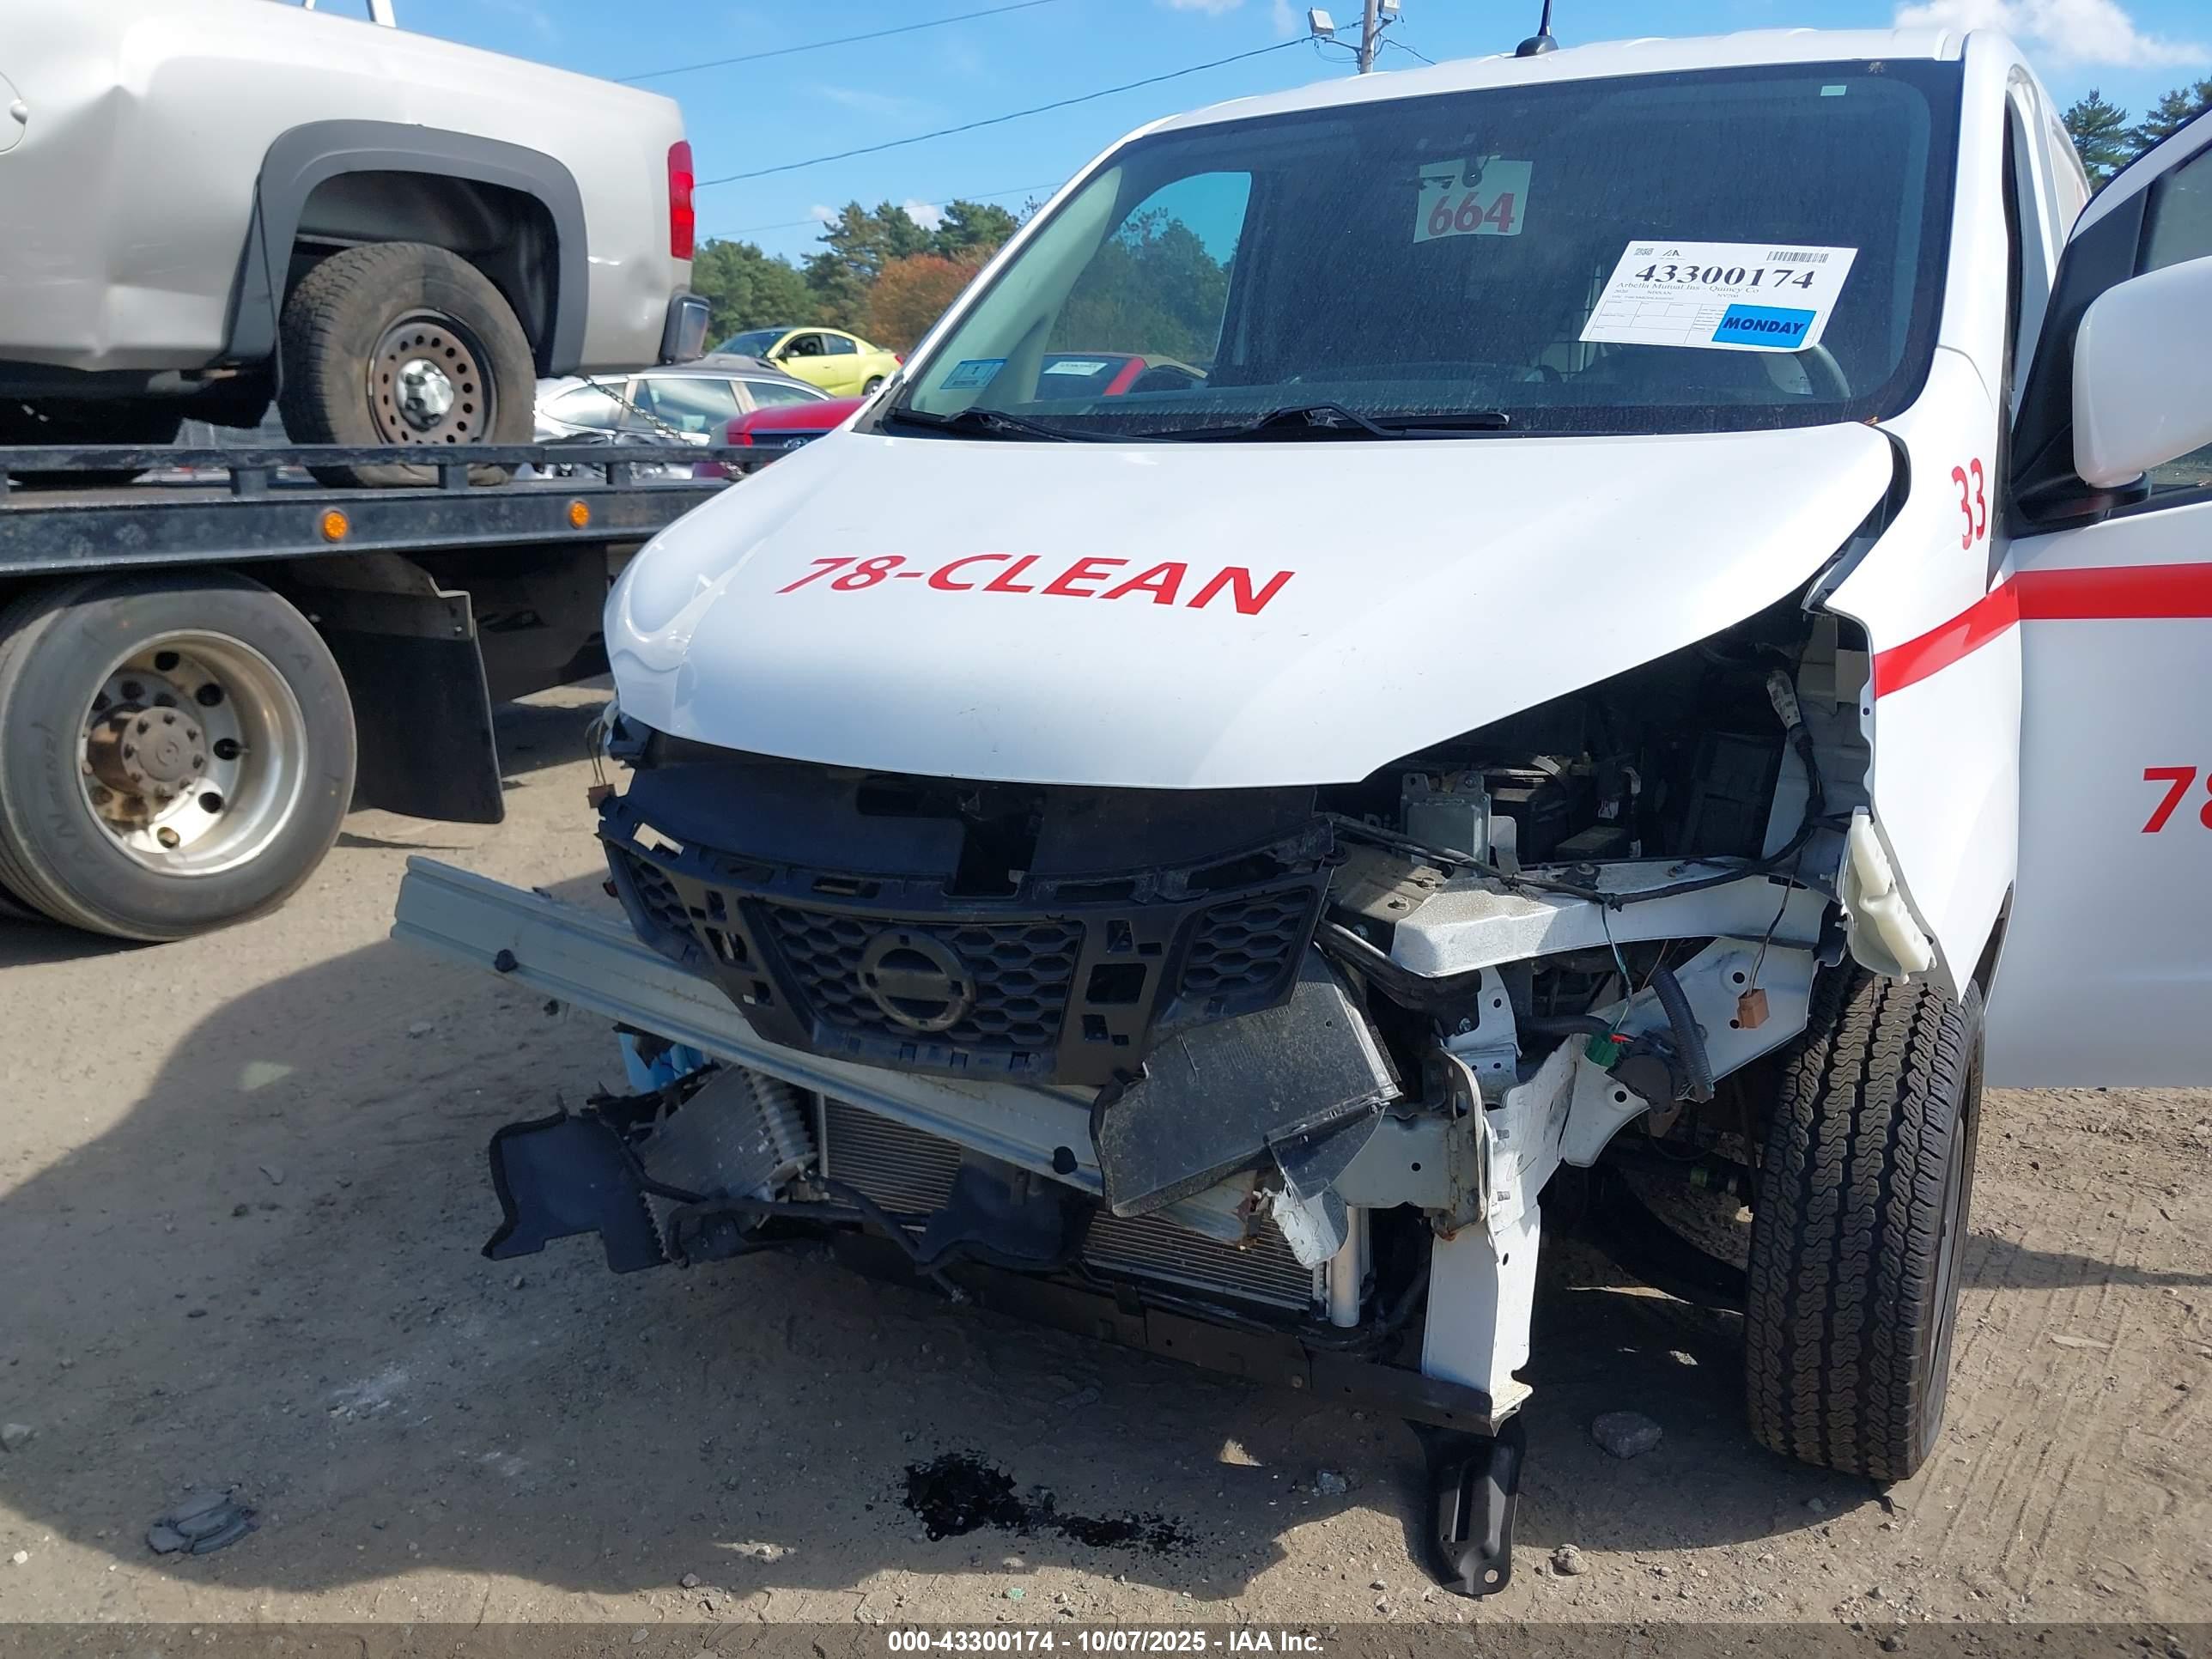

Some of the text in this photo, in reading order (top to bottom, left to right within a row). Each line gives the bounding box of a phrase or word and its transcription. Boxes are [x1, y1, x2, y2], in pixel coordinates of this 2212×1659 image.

[1428, 191, 1515, 236] 664
[1635, 264, 1814, 289] 43300174
[1723, 317, 1805, 336] MONDAY
[1951, 458, 1986, 550] 33
[775, 554, 1296, 616] 78-CLEAN
[2140, 766, 2212, 834] 7
